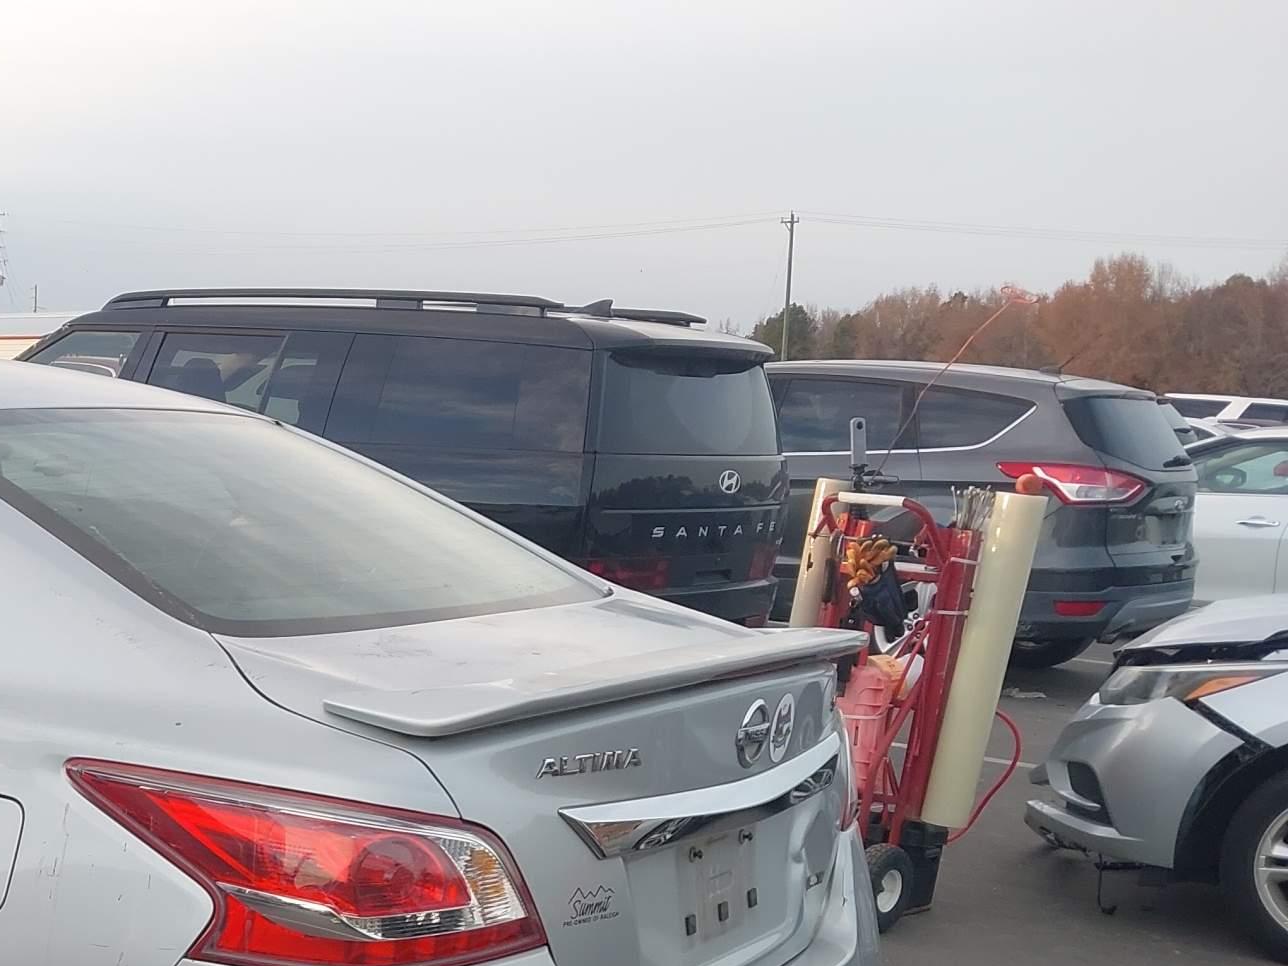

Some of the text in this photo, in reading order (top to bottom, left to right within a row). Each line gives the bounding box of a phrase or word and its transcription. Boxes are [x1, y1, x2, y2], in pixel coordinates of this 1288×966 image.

[651, 520, 777, 538] SANTA FE
[535, 747, 642, 779] ALTIMA
[569, 894, 612, 920] Summit
